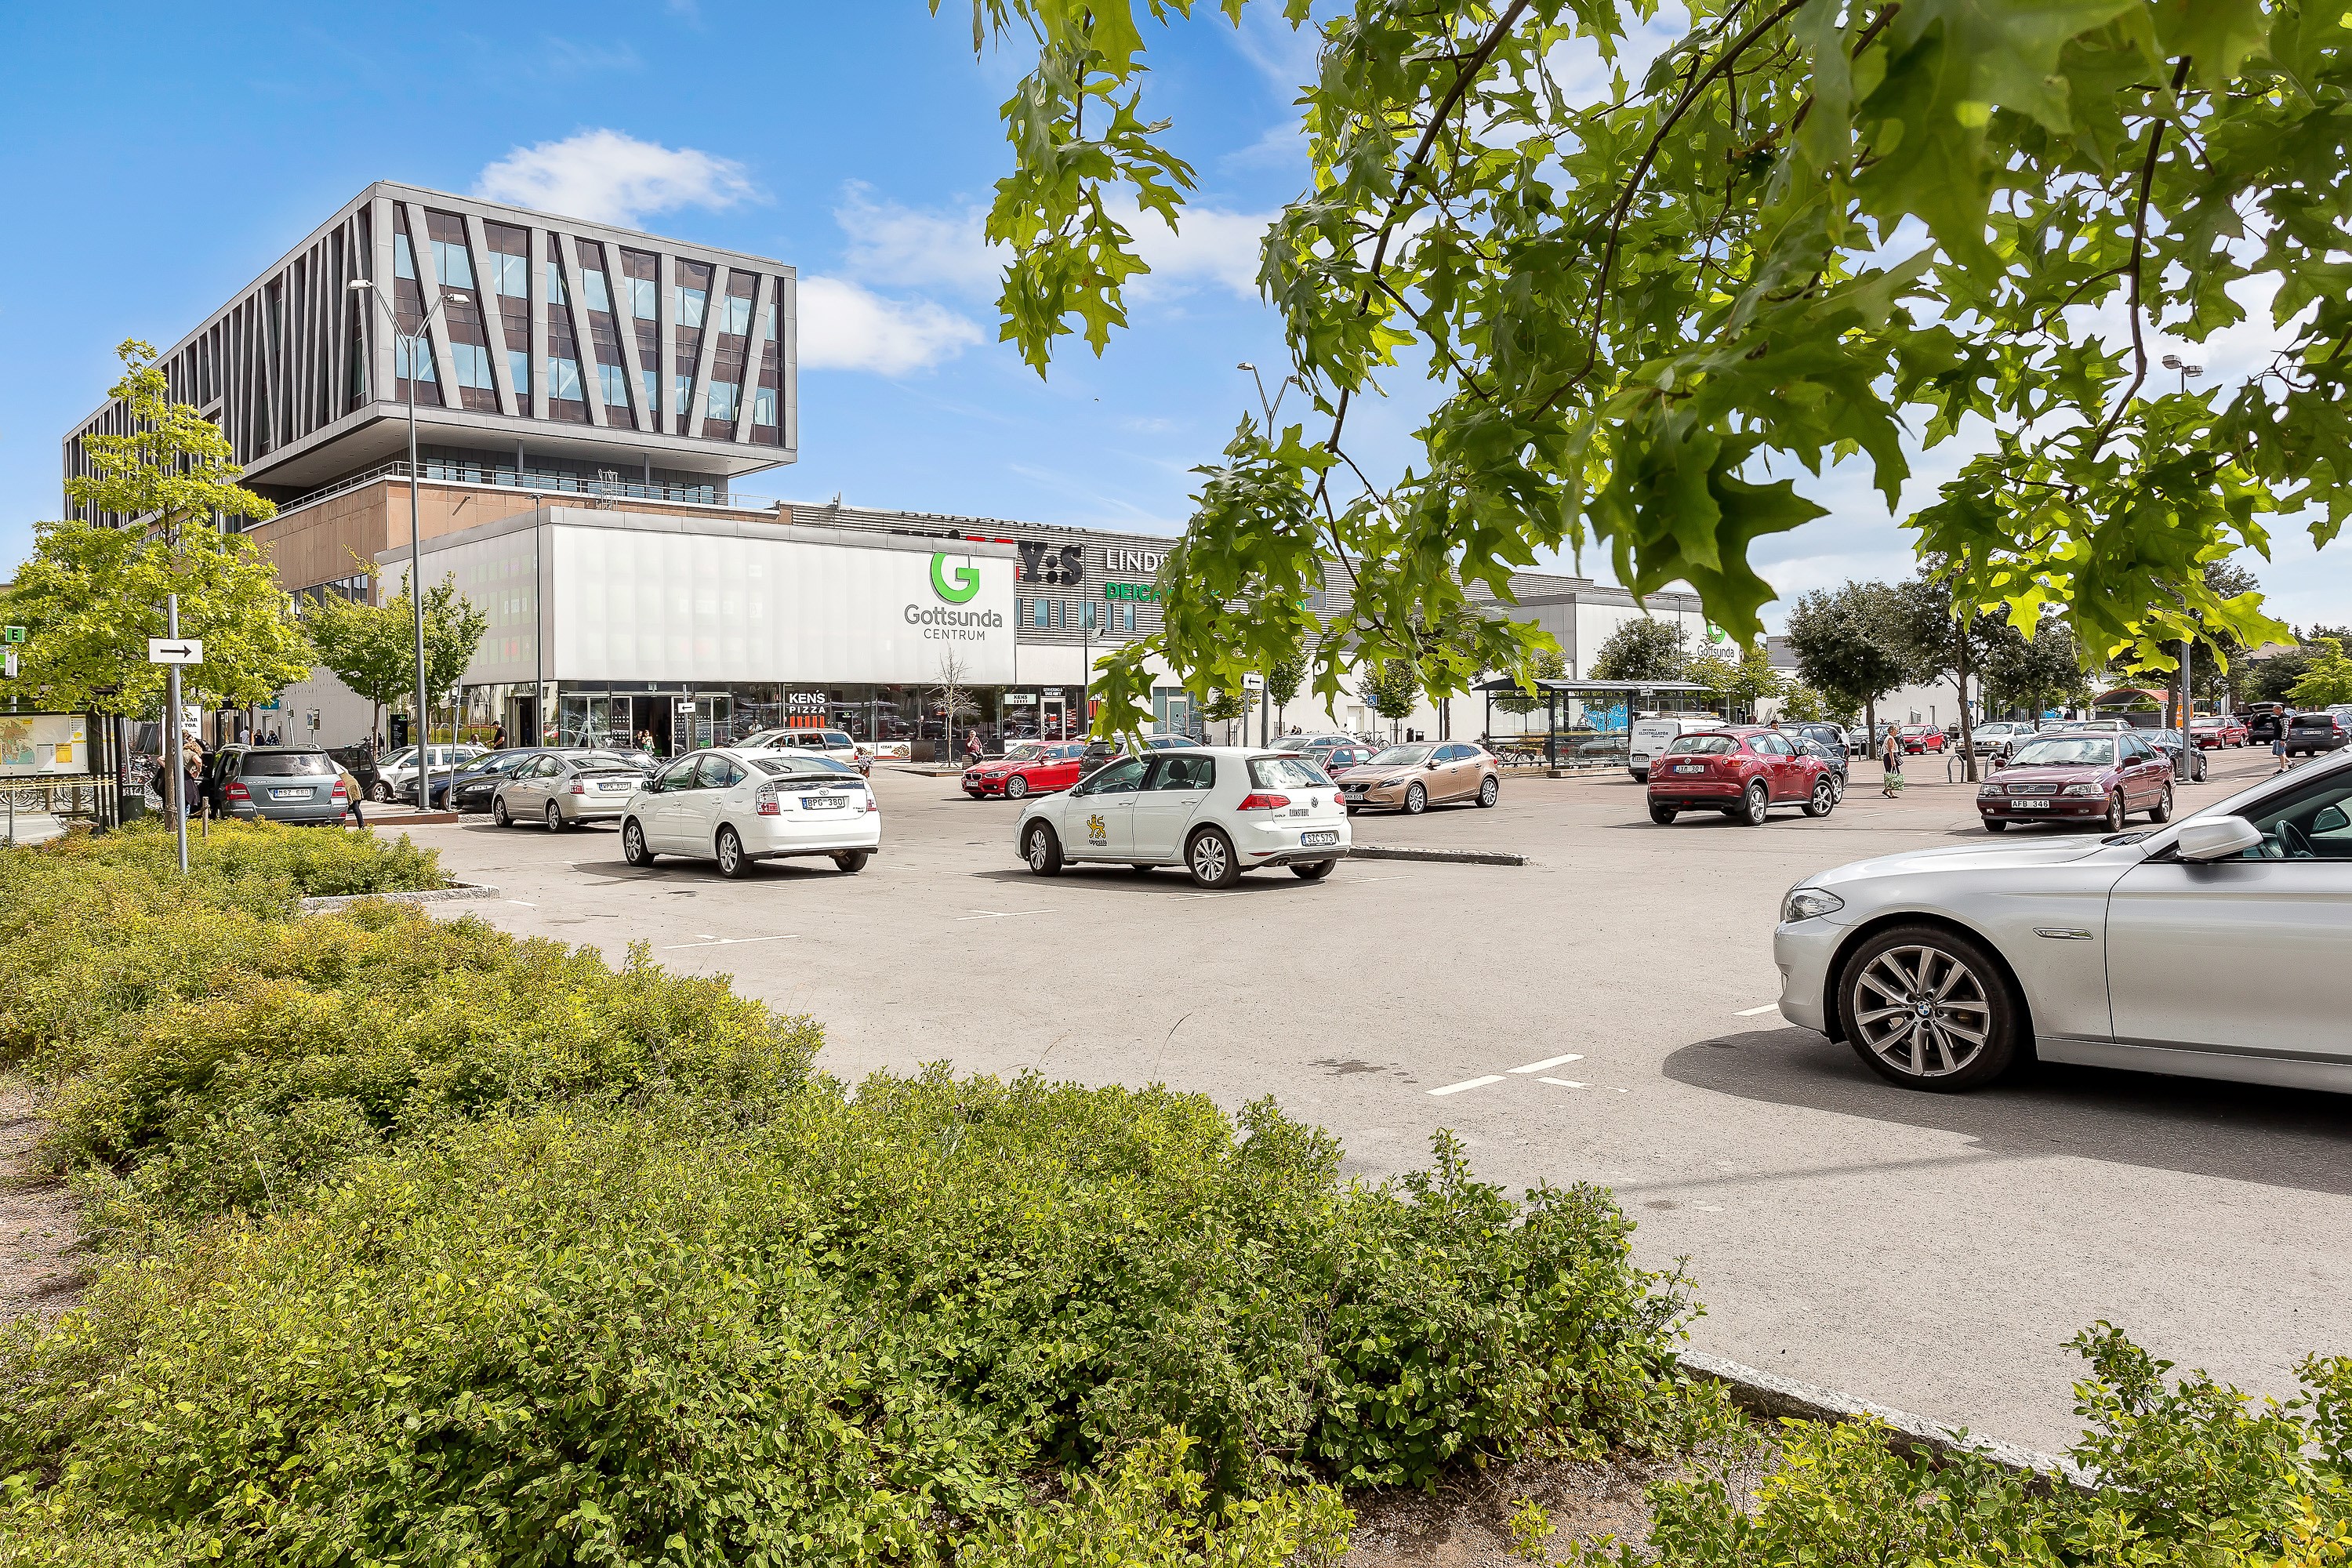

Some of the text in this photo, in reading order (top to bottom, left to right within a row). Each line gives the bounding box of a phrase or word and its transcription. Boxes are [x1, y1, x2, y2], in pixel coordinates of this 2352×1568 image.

[904, 604, 1003, 628] Gottsunda
[11, 629, 19, 641] E
[924, 628, 985, 641] CENTRUM
[1697, 644, 1735, 658] Gottsunda
[789, 706, 826, 714] PIZZA
[1307, 833, 1334, 843] SZC 575
